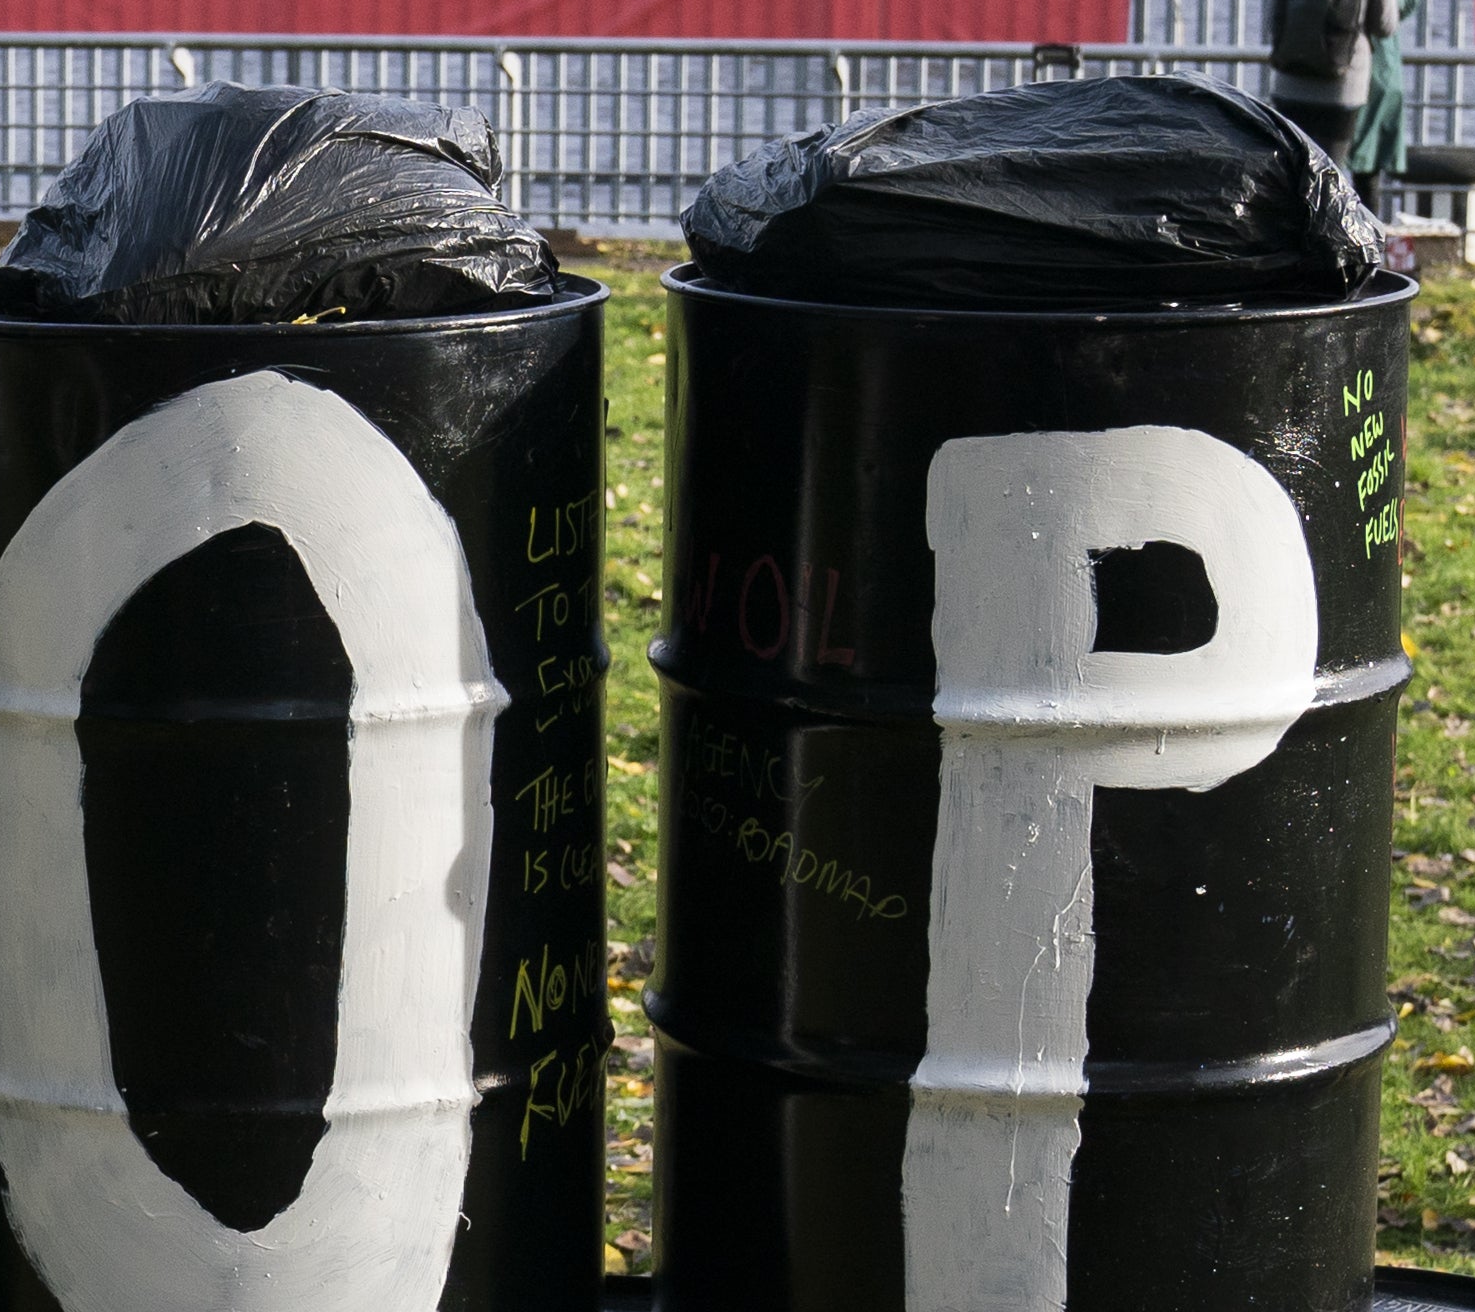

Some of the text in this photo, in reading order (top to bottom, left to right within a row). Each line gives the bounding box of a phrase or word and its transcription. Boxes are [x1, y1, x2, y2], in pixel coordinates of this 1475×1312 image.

[1343, 369, 1374, 417] NO
[1350, 410, 1384, 462] NEW
[1357, 437, 1395, 513] FOSSIL
[513, 582, 568, 642] TO
[515, 765, 574, 833] THE
